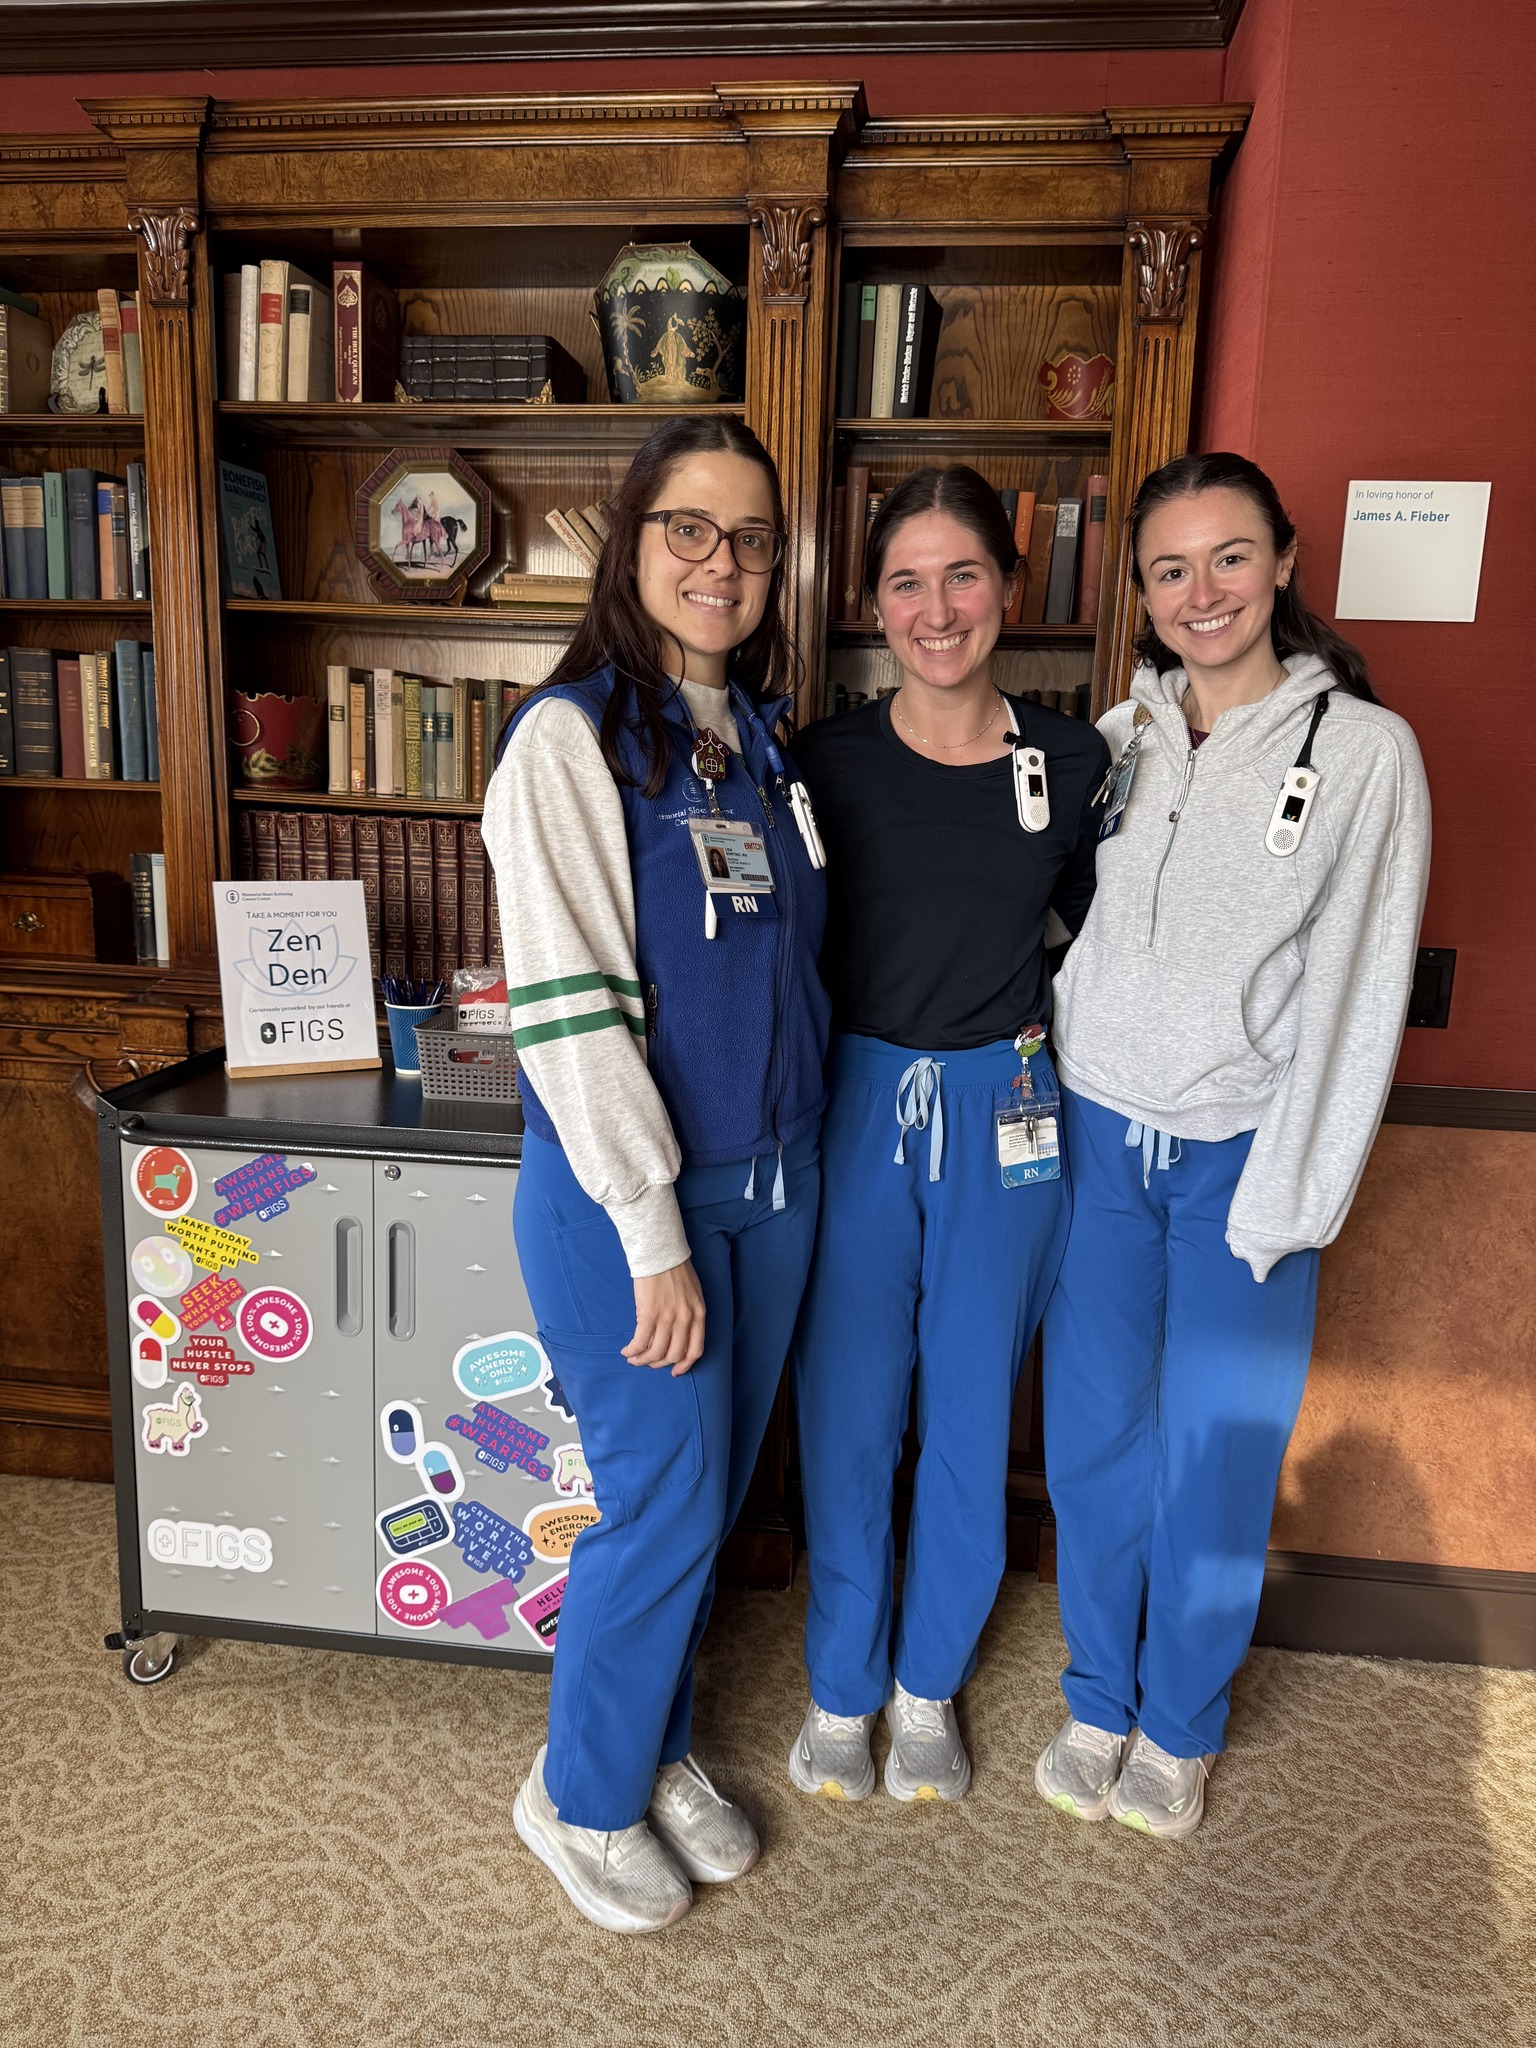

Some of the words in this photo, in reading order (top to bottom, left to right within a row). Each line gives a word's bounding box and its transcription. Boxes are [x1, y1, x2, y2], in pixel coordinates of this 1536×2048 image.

[223, 468, 266, 493] BONEFISH
[1355, 490, 1364, 499] In
[1366, 490, 1394, 500] loving
[1396, 490, 1422, 499] honor
[1424, 490, 1434, 500] of
[1353, 510, 1392, 522] James
[1394, 511, 1407, 522] A.
[1410, 511, 1450, 522] Fieber
[731, 895, 759, 912] RN
[267, 928, 322, 952] Zen
[268, 964, 328, 986] Den
[281, 1018, 344, 1043] FIGS
[216, 1154, 282, 1192] AWESOME
[228, 1166, 284, 1201] HUMANS
[217, 1168, 312, 1224] #WEARFIGS
[264, 1200, 287, 1216] FIGS
[167, 1224, 206, 1243] WORTH
[210, 1240, 257, 1261] PUTTING
[181, 1218, 210, 1232] MAKE
[214, 1229, 249, 1246] TODAY
[183, 1241, 216, 1258] PANTS
[221, 1256, 235, 1265] ON
[200, 1258, 219, 1270] FIGS
[181, 1299, 210, 1322] WHAT
[212, 1280, 237, 1301] SETS
[182, 1276, 222, 1308] SEEK
[187, 1312, 209, 1328] YOUR
[209, 1298, 230, 1314] SOUL
[230, 1288, 242, 1298] ON
[255, 1296, 298, 1315] AWESOME
[246, 1308, 257, 1332] 100%
[292, 1317, 303, 1342] 100%
[192, 1338, 224, 1346] YOUR
[251, 1334, 294, 1352] AWESOME
[172, 1361, 210, 1370] NEVER
[214, 1363, 251, 1372] STOPS
[186, 1350, 232, 1359] HUSTLE
[470, 1350, 526, 1371] AWESOME
[480, 1358, 519, 1374] ENERGY
[206, 1375, 225, 1384] FIGS
[490, 1366, 513, 1378] ONLY
[476, 1404, 546, 1447] AWESOME
[476, 1417, 534, 1455] HUMANS
[448, 1418, 548, 1479] #WEARFIGS
[484, 1453, 506, 1470] FIGS
[457, 1508, 528, 1561] WORLD
[471, 1506, 506, 1532] CREATE
[509, 1531, 527, 1547] THE
[540, 1514, 597, 1532] AWESOME
[182, 1528, 266, 1566] FIGS
[460, 1523, 476, 1537] YOU
[478, 1536, 503, 1554] WANT
[505, 1554, 515, 1564] TO
[559, 1531, 580, 1540] ONL
[458, 1534, 491, 1561] IVE
[497, 1560, 518, 1579] IN
[471, 1556, 484, 1569] FIGS
[387, 1568, 424, 1590] AWESOME
[425, 1574, 440, 1597] 100%
[386, 1592, 402, 1615] 100%
[404, 1598, 440, 1622] AWESOME
